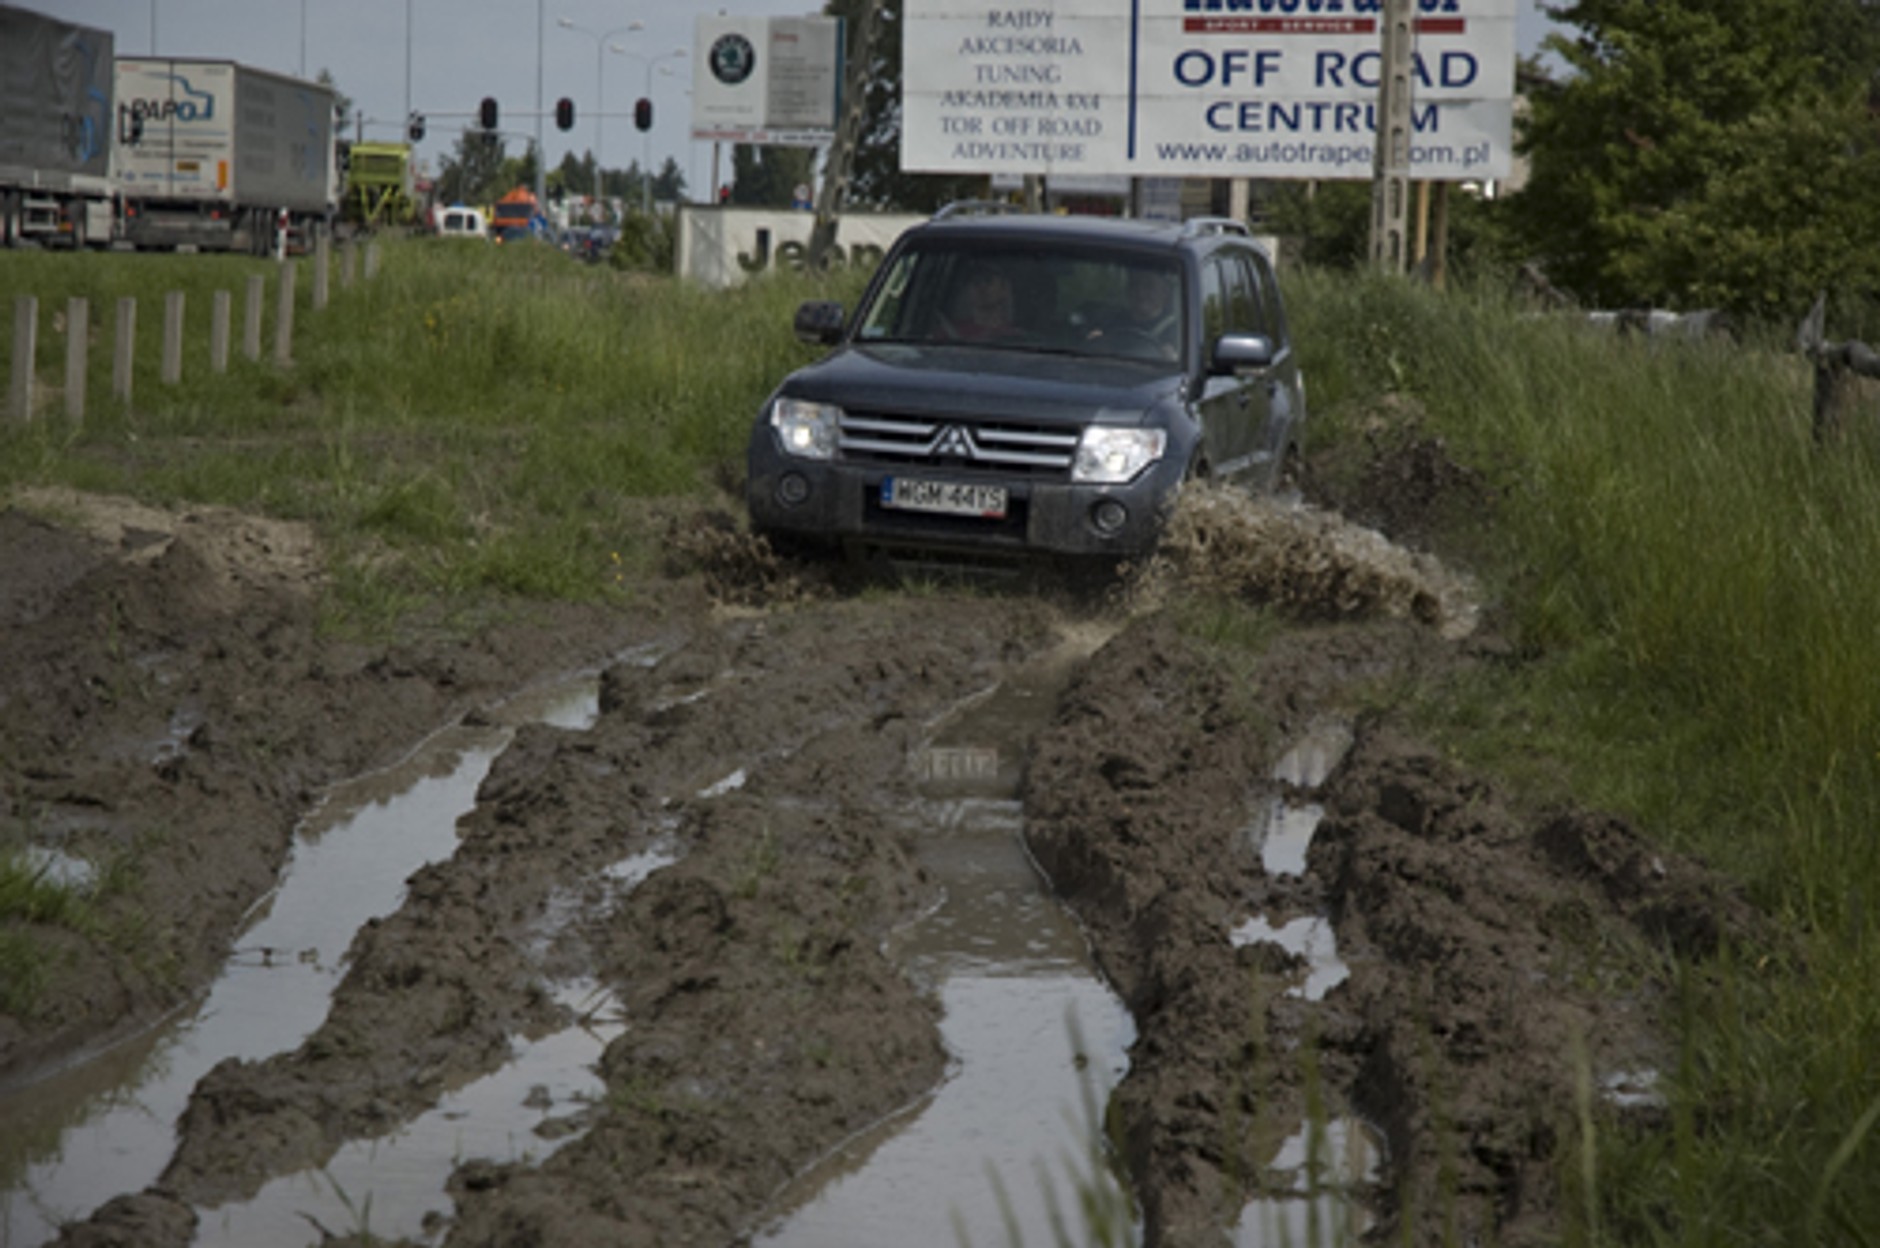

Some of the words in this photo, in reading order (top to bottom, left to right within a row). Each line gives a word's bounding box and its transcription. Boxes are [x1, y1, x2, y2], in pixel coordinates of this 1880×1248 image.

[988, 10, 1053, 28] RAJDY
[959, 37, 1083, 54] AKCESORIA
[975, 64, 1061, 83] TUNING
[1173, 49, 1283, 87] OFF
[1314, 51, 1478, 88] ROAD
[941, 91, 1059, 108] AKADEMIA
[941, 117, 982, 134] TOR
[992, 118, 1031, 135] OFF
[1037, 118, 1102, 136] ROAD
[952, 143, 1084, 161] ADVENTURE
